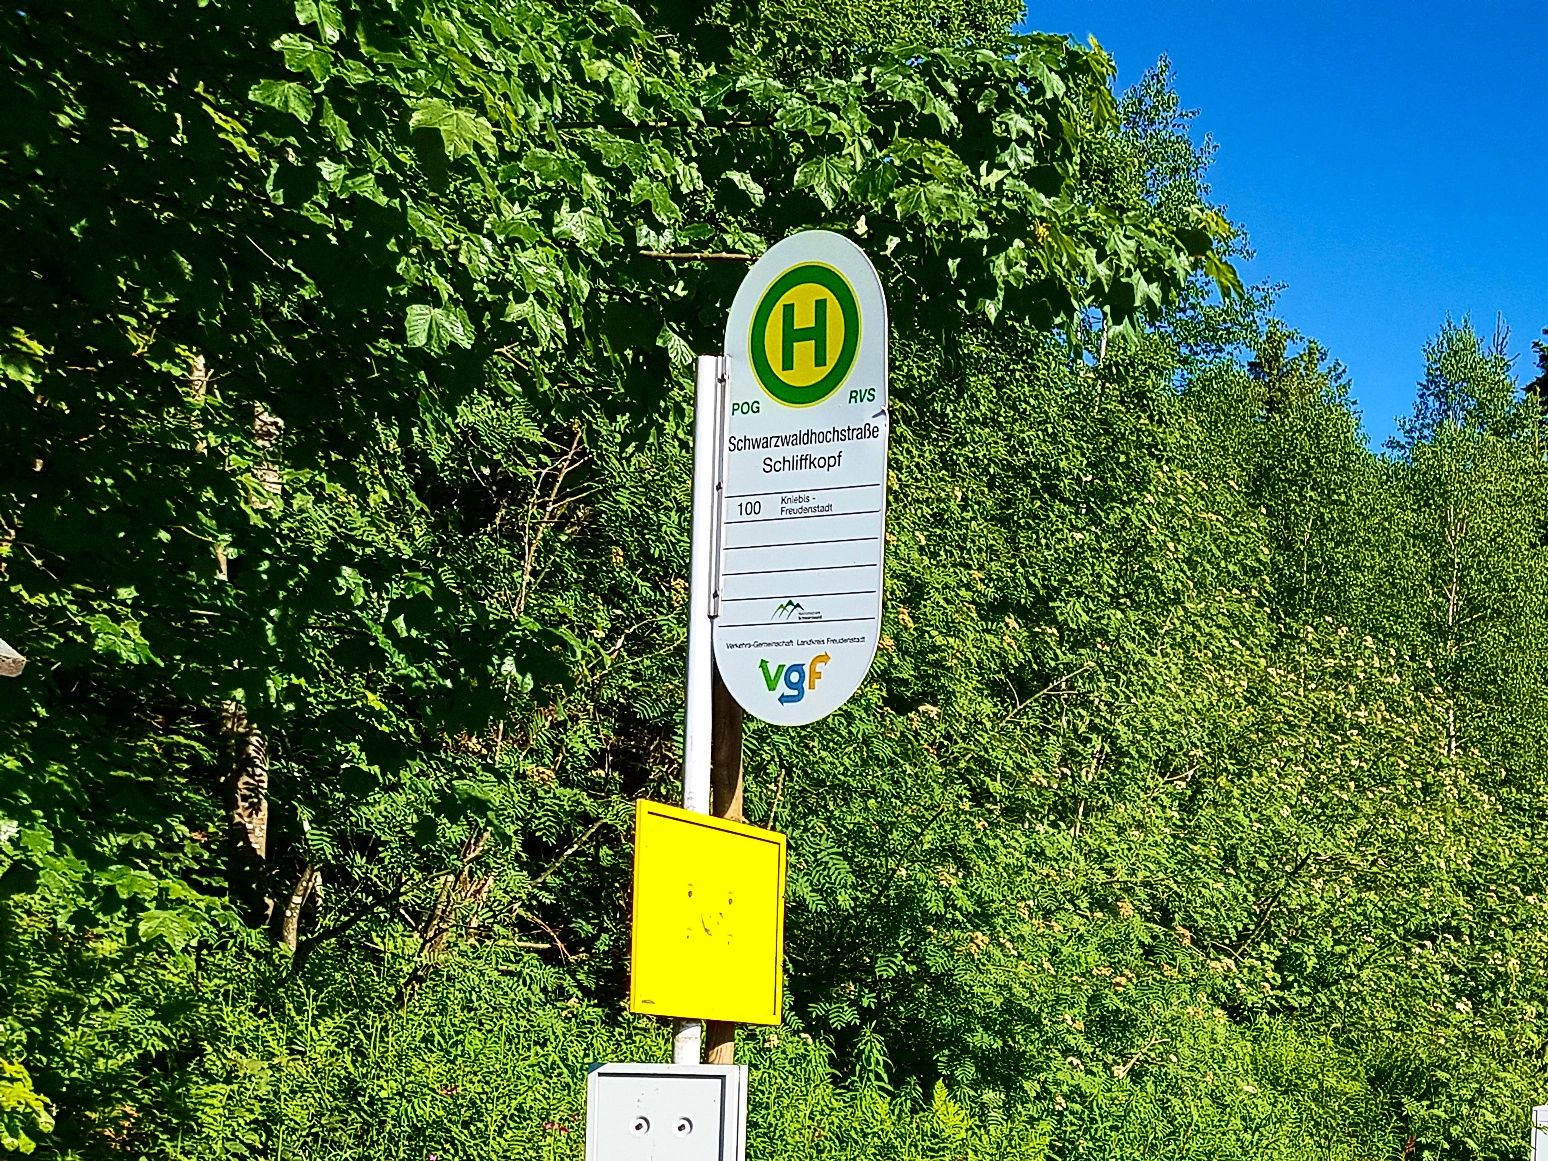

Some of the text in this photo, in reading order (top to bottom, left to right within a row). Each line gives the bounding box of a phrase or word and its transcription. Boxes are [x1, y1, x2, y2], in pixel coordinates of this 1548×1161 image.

[781, 297, 828, 372] H
[848, 387, 876, 405] RVS
[731, 400, 761, 416] POG
[728, 422, 880, 452] Schwarzwaldhochstraße
[762, 450, 843, 474] Schliffkopf
[737, 500, 762, 516] 100
[780, 495, 811, 505] Kniebis
[780, 502, 833, 516] Freudenstadt
